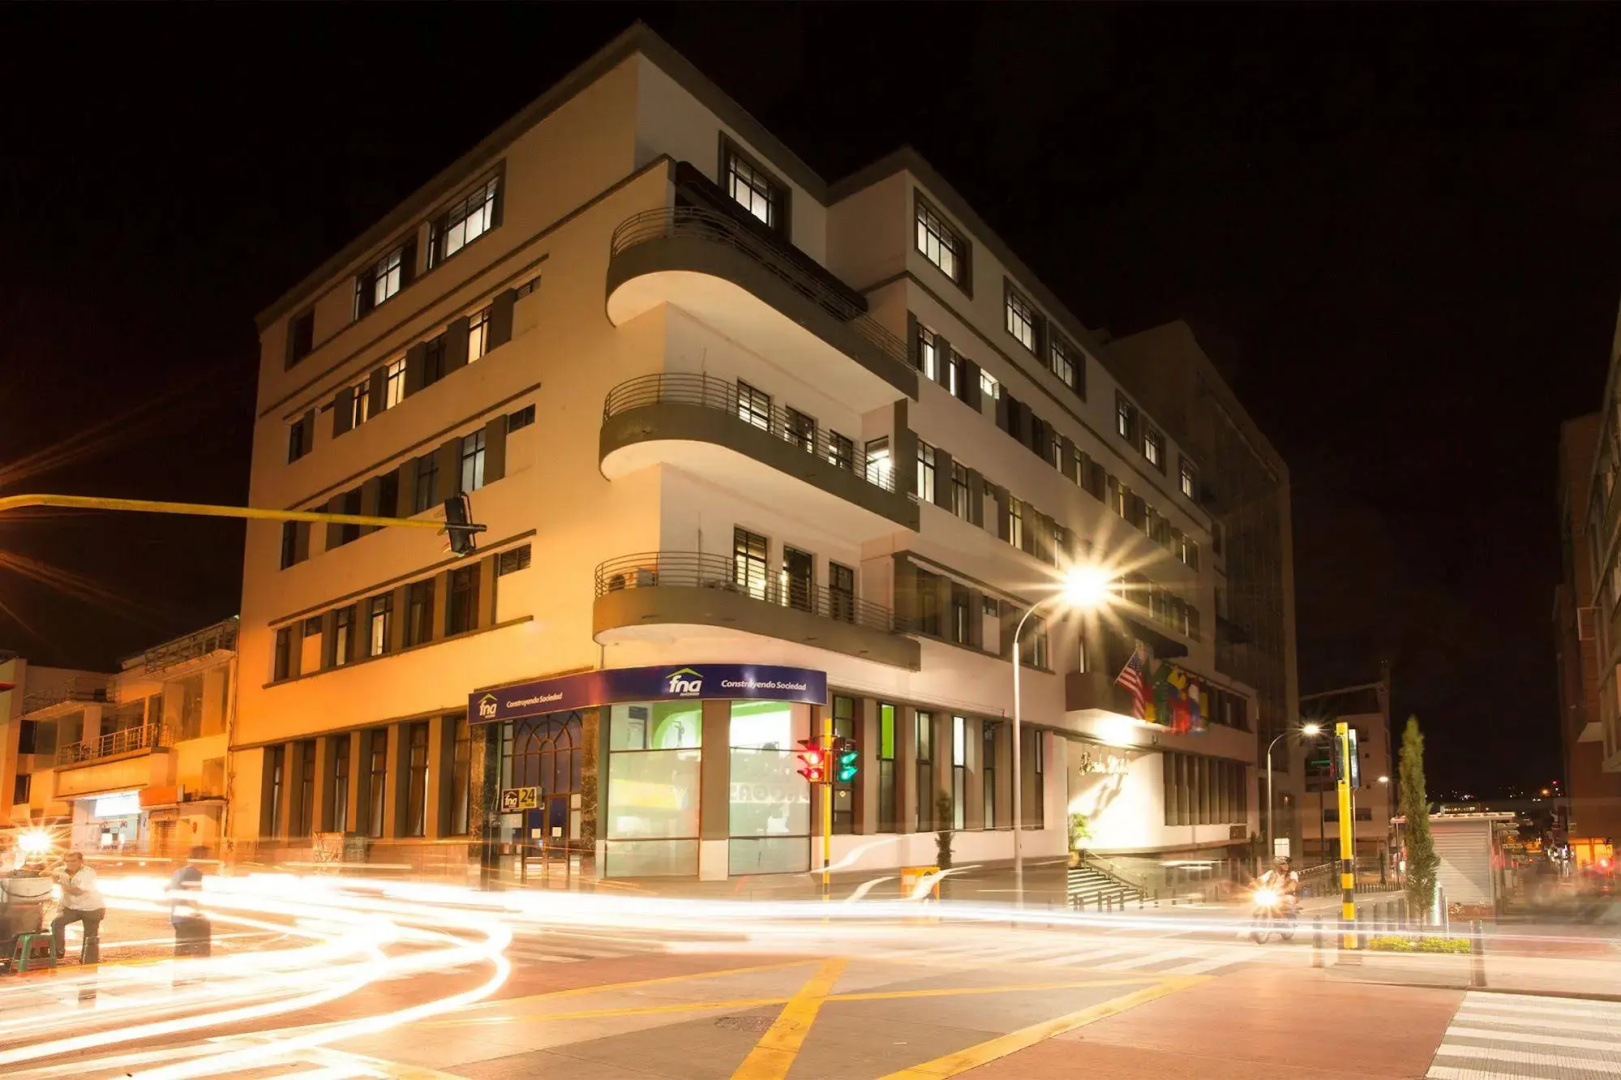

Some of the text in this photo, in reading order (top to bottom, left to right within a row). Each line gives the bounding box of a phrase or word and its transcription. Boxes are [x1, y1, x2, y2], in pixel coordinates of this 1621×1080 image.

[669, 674, 702, 693] fna
[721, 679, 806, 691] Construyendo Sociedad
[480, 700, 497, 716] fna
[507, 692, 563, 708] Construyendo Sociedad
[521, 788, 535, 802] 24
